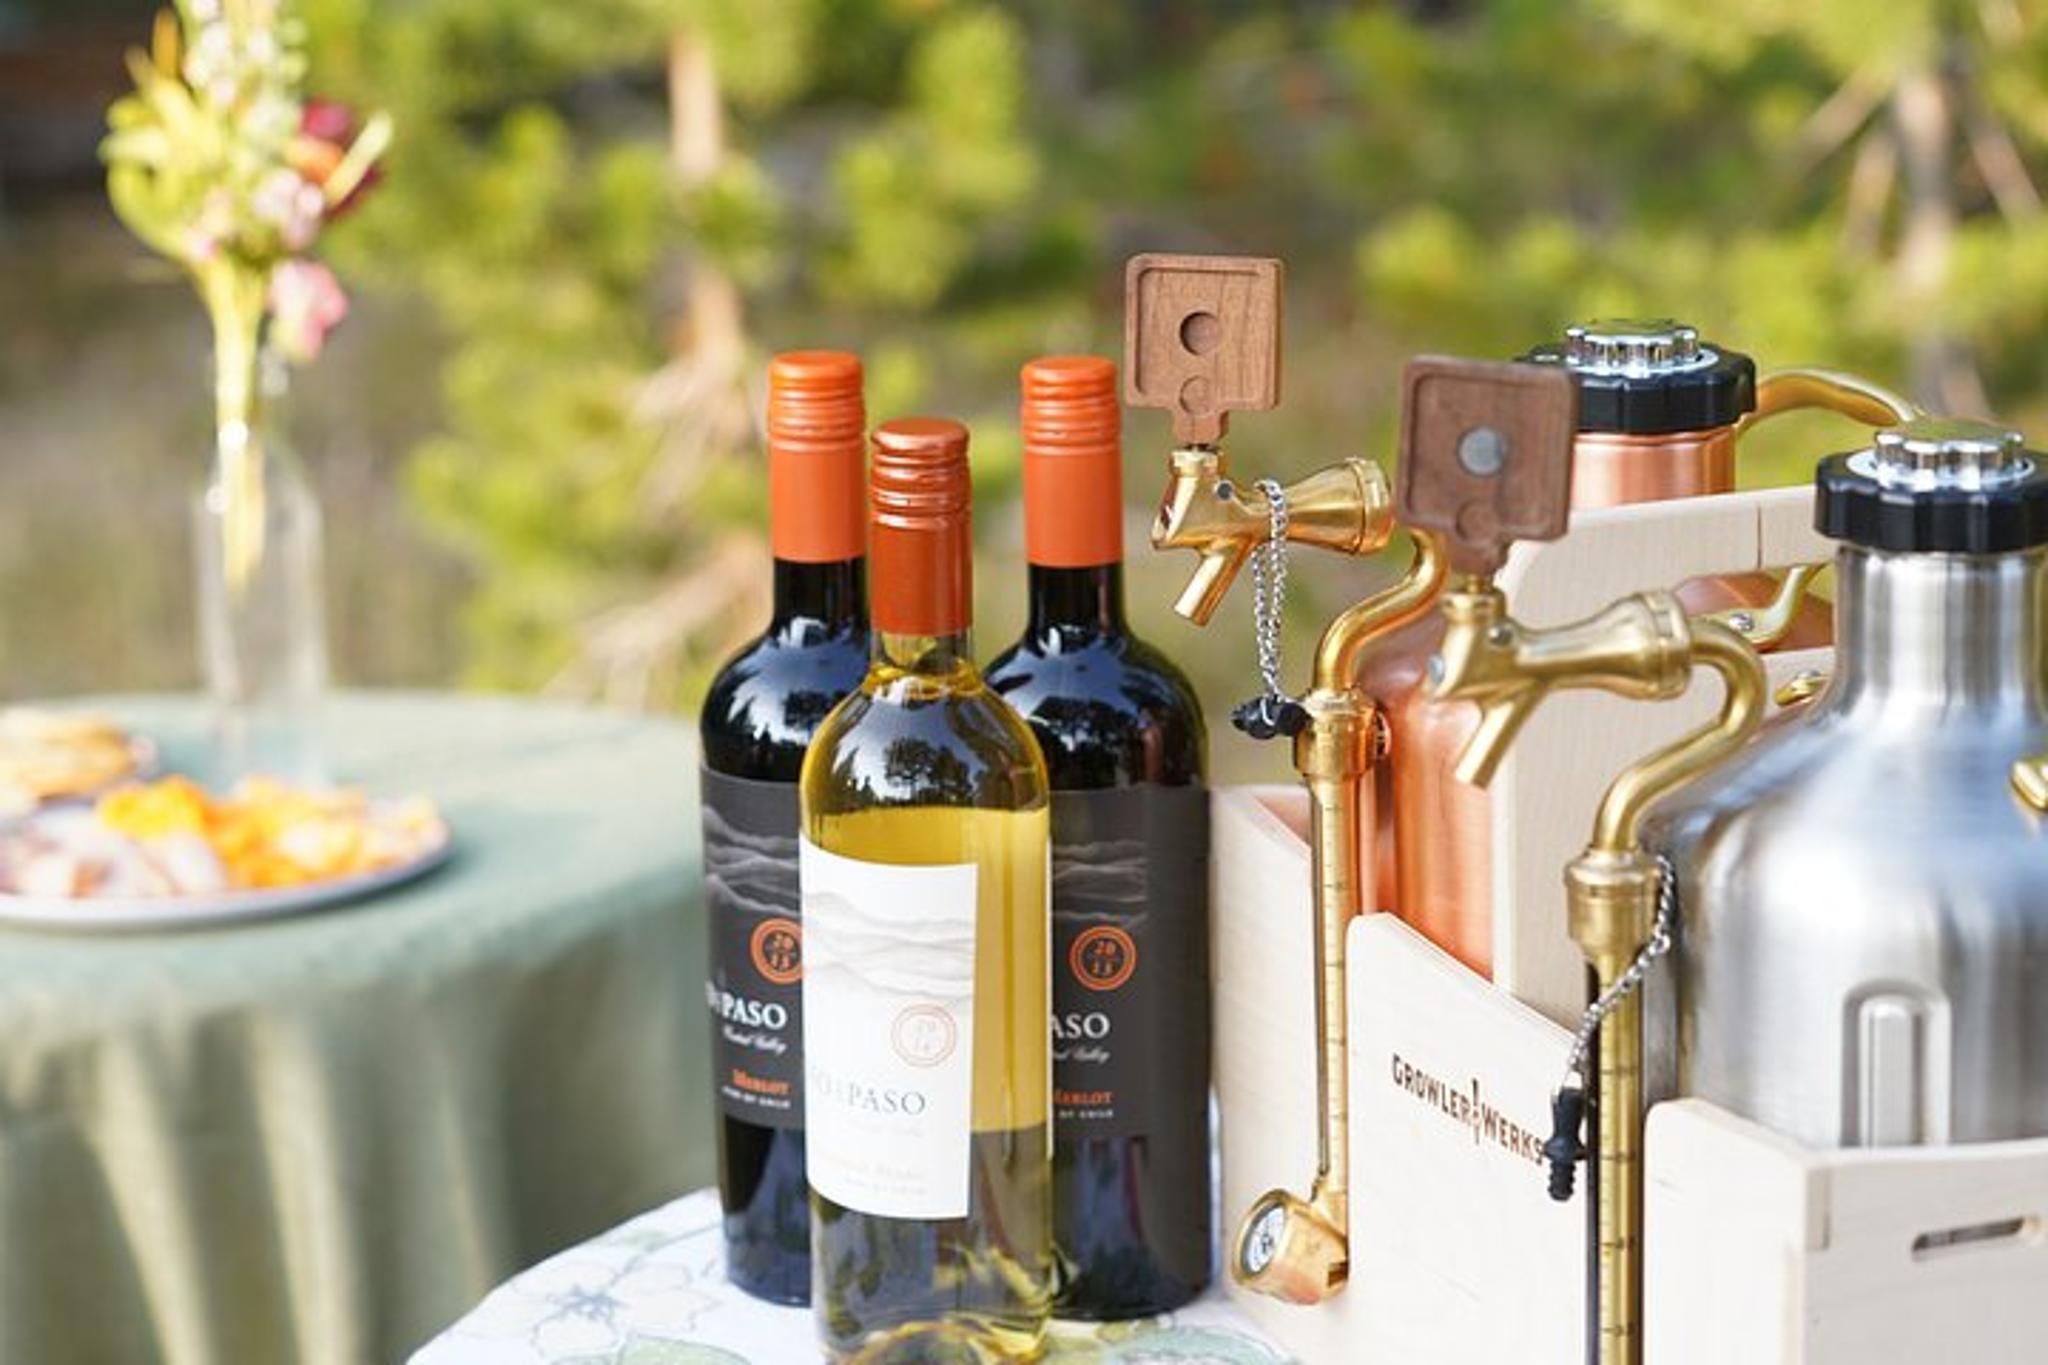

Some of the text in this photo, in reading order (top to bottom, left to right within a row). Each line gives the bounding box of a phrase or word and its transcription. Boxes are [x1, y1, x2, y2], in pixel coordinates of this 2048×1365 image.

[720, 991, 788, 1031] PASO
[845, 1080, 927, 1118] PASO
[1391, 1052, 1545, 1167] GROWLER WERKS
